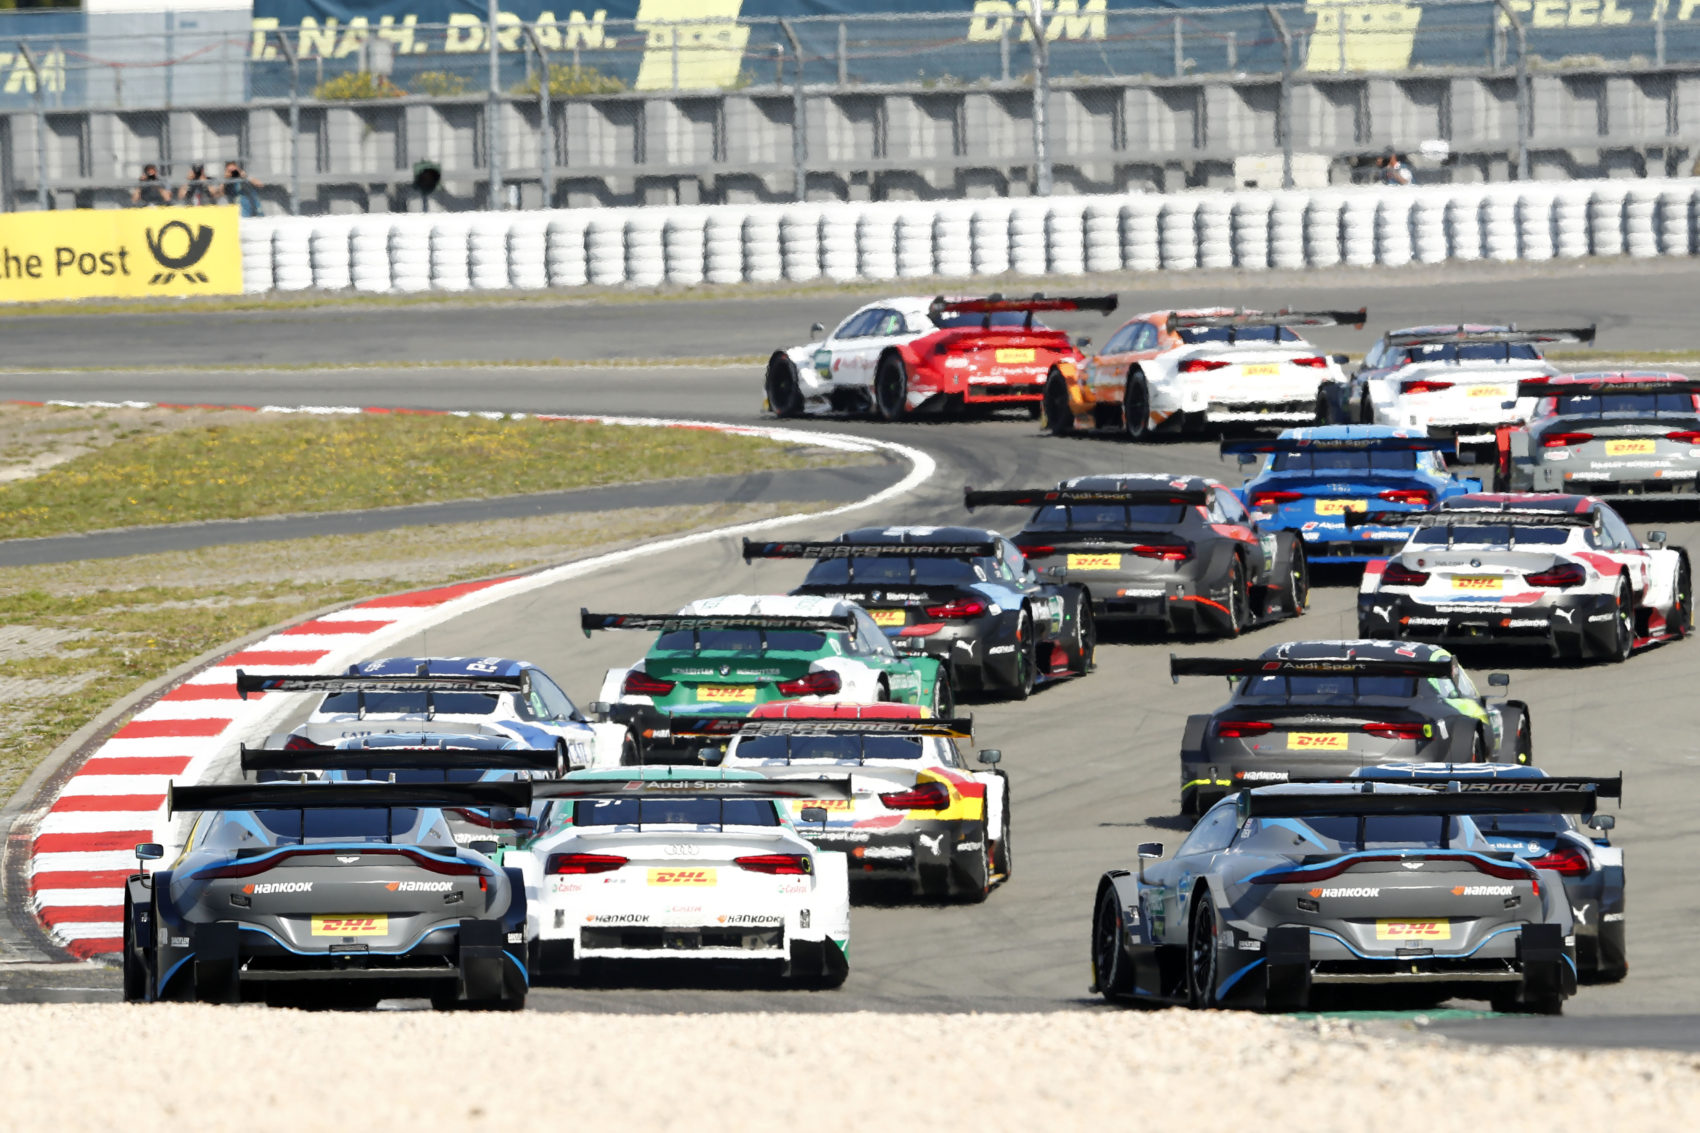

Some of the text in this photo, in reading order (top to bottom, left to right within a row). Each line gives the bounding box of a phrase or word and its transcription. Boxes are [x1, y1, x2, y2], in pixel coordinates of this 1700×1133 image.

[967, 0, 1108, 42] DTM
[444, 8, 618, 50] DRAN.
[0, 247, 130, 278] he Post
[1075, 557, 1113, 566] DHL
[1458, 578, 1496, 588] DHL
[1283, 662, 1366, 671] Audi Sport
[706, 687, 747, 698] DHL
[1297, 735, 1338, 746] DHL
[646, 780, 746, 791] Audi Sport
[656, 871, 708, 883] DHL
[323, 918, 377, 931] DHL
[1387, 922, 1441, 935] DHL
